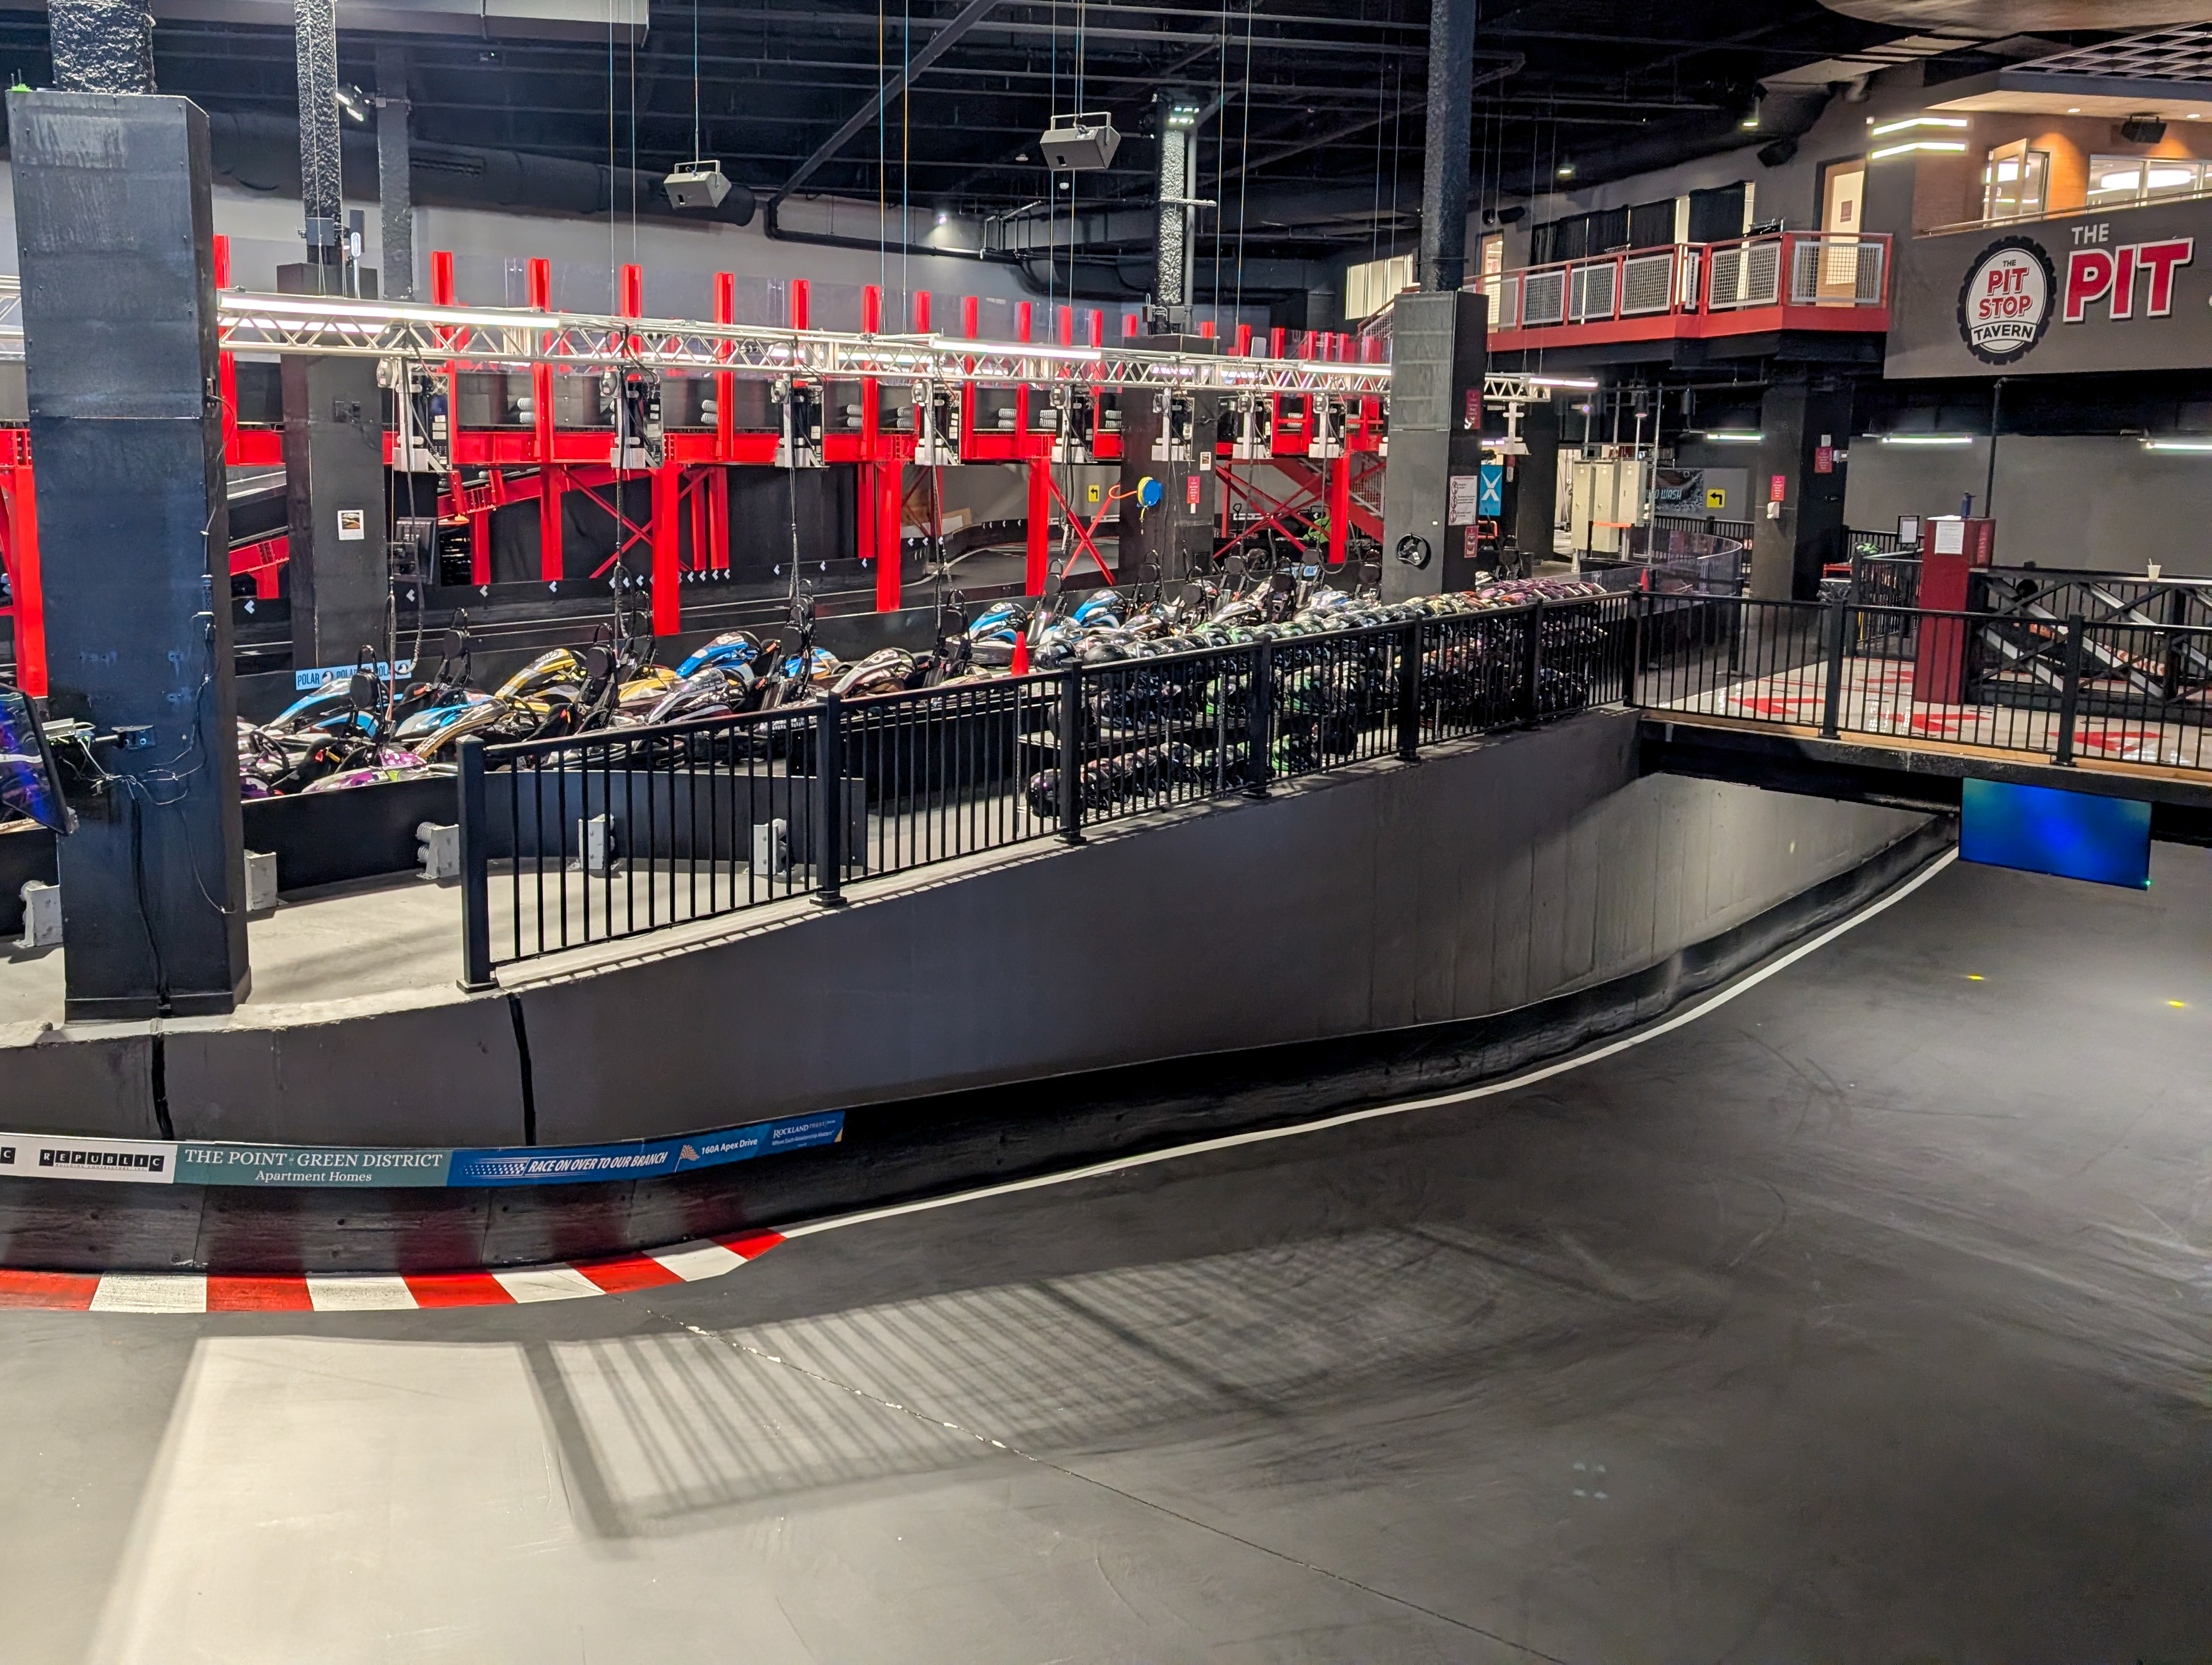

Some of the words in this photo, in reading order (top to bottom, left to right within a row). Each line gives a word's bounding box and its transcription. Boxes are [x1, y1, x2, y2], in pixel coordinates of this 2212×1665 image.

[2071, 223, 2109, 244] THE
[2003, 259, 2016, 267] THE
[1987, 267, 2029, 296] PIT
[2062, 237, 2194, 323] PIT
[1978, 295, 2032, 320] STOP
[1974, 324, 2033, 341] TAVERN
[1660, 489, 1682, 500] WASH
[297, 673, 320, 686] POLAR
[701, 1146, 719, 1155] 160A
[720, 1142, 739, 1153] Apex
[739, 1138, 758, 1148] Drive
[42, 1151, 162, 1168] REPUBLIC
[185, 1149, 223, 1165] THE
[227, 1152, 287, 1166] POINT
[297, 1153, 358, 1167] GREEN
[362, 1155, 443, 1168] DISTRICT
[528, 1159, 557, 1173] RACE
[555, 1159, 572, 1171] ON
[571, 1158, 598, 1171] OVER
[598, 1157, 611, 1169] TO
[610, 1155, 631, 1169] OUR
[631, 1152, 669, 1167] BRANCH
[255, 1170, 325, 1183] Apartment
[329, 1171, 372, 1183] Homes
